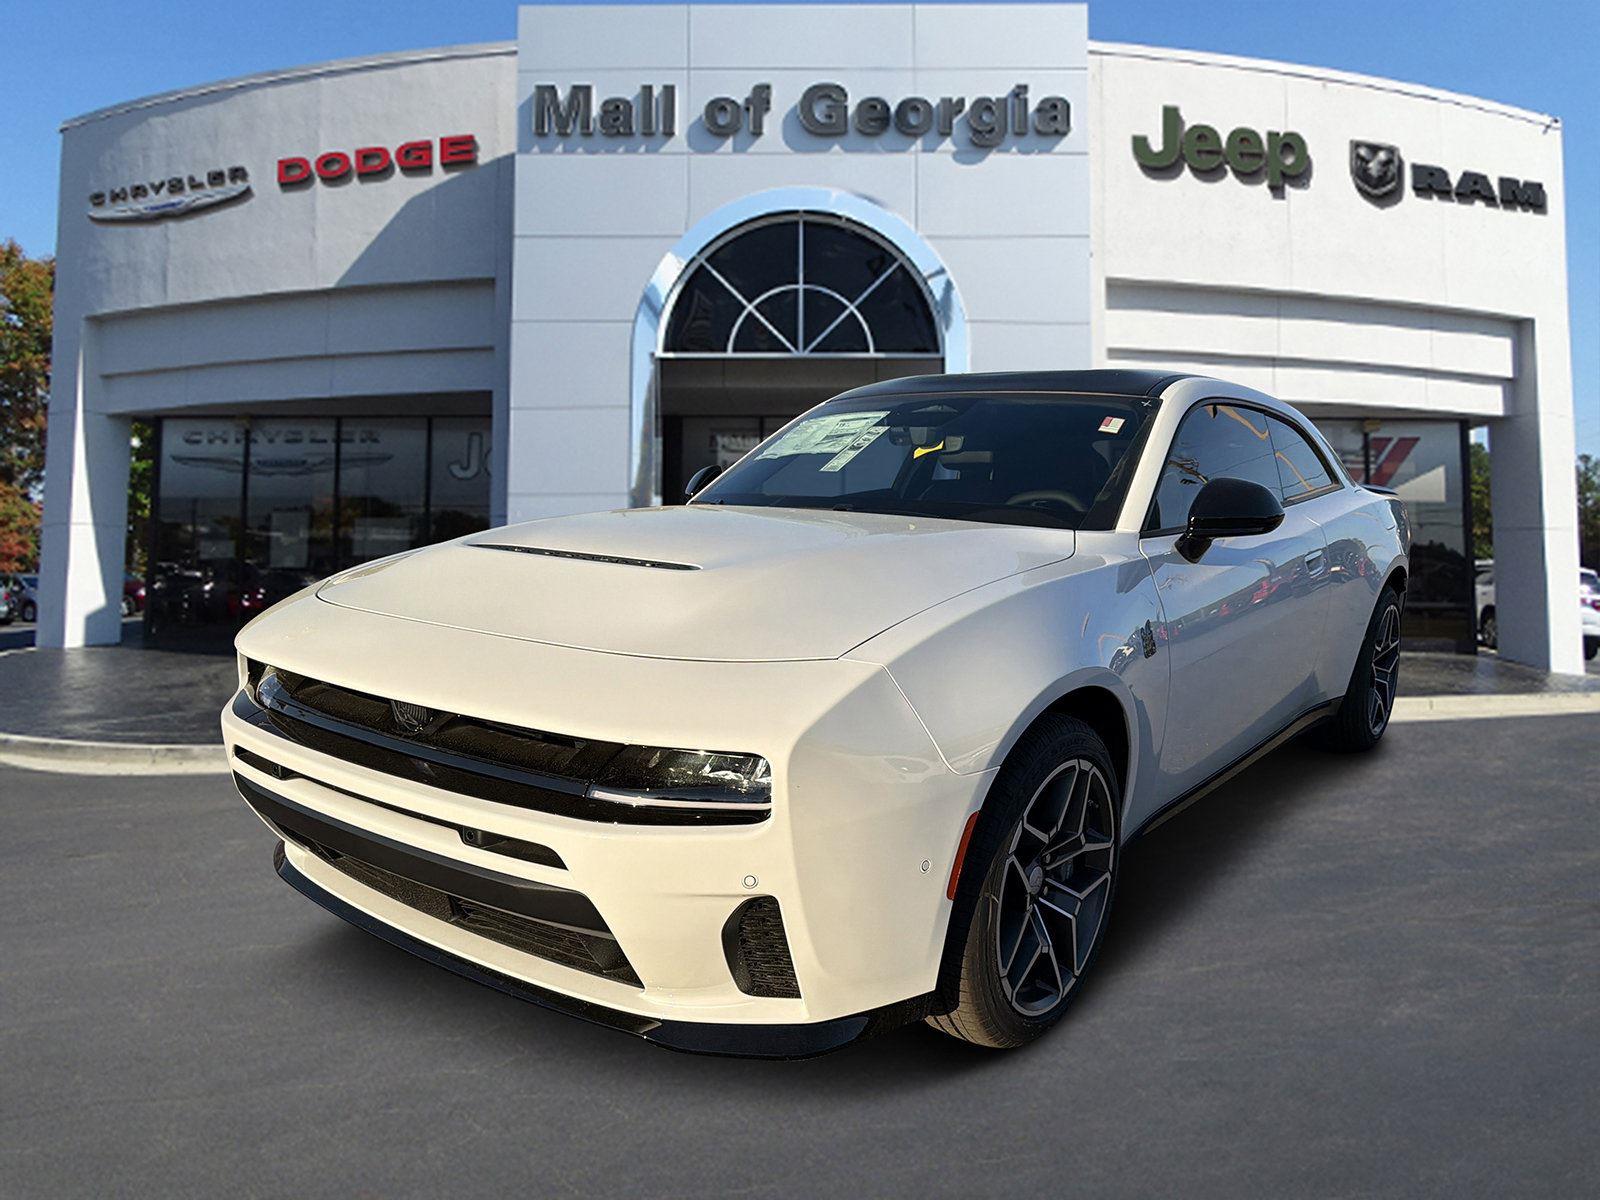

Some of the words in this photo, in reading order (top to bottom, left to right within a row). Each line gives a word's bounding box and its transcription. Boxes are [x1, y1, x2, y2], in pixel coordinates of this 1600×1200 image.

[532, 84, 677, 137] Mall
[704, 84, 772, 137] of
[800, 83, 1072, 147] Georgia
[277, 134, 478, 188] DODGE
[1131, 105, 1310, 194] Jeep
[89, 165, 249, 207] CHRYSLER
[1411, 163, 1548, 215] RAM
[183, 430, 380, 444] CHRYSLER
